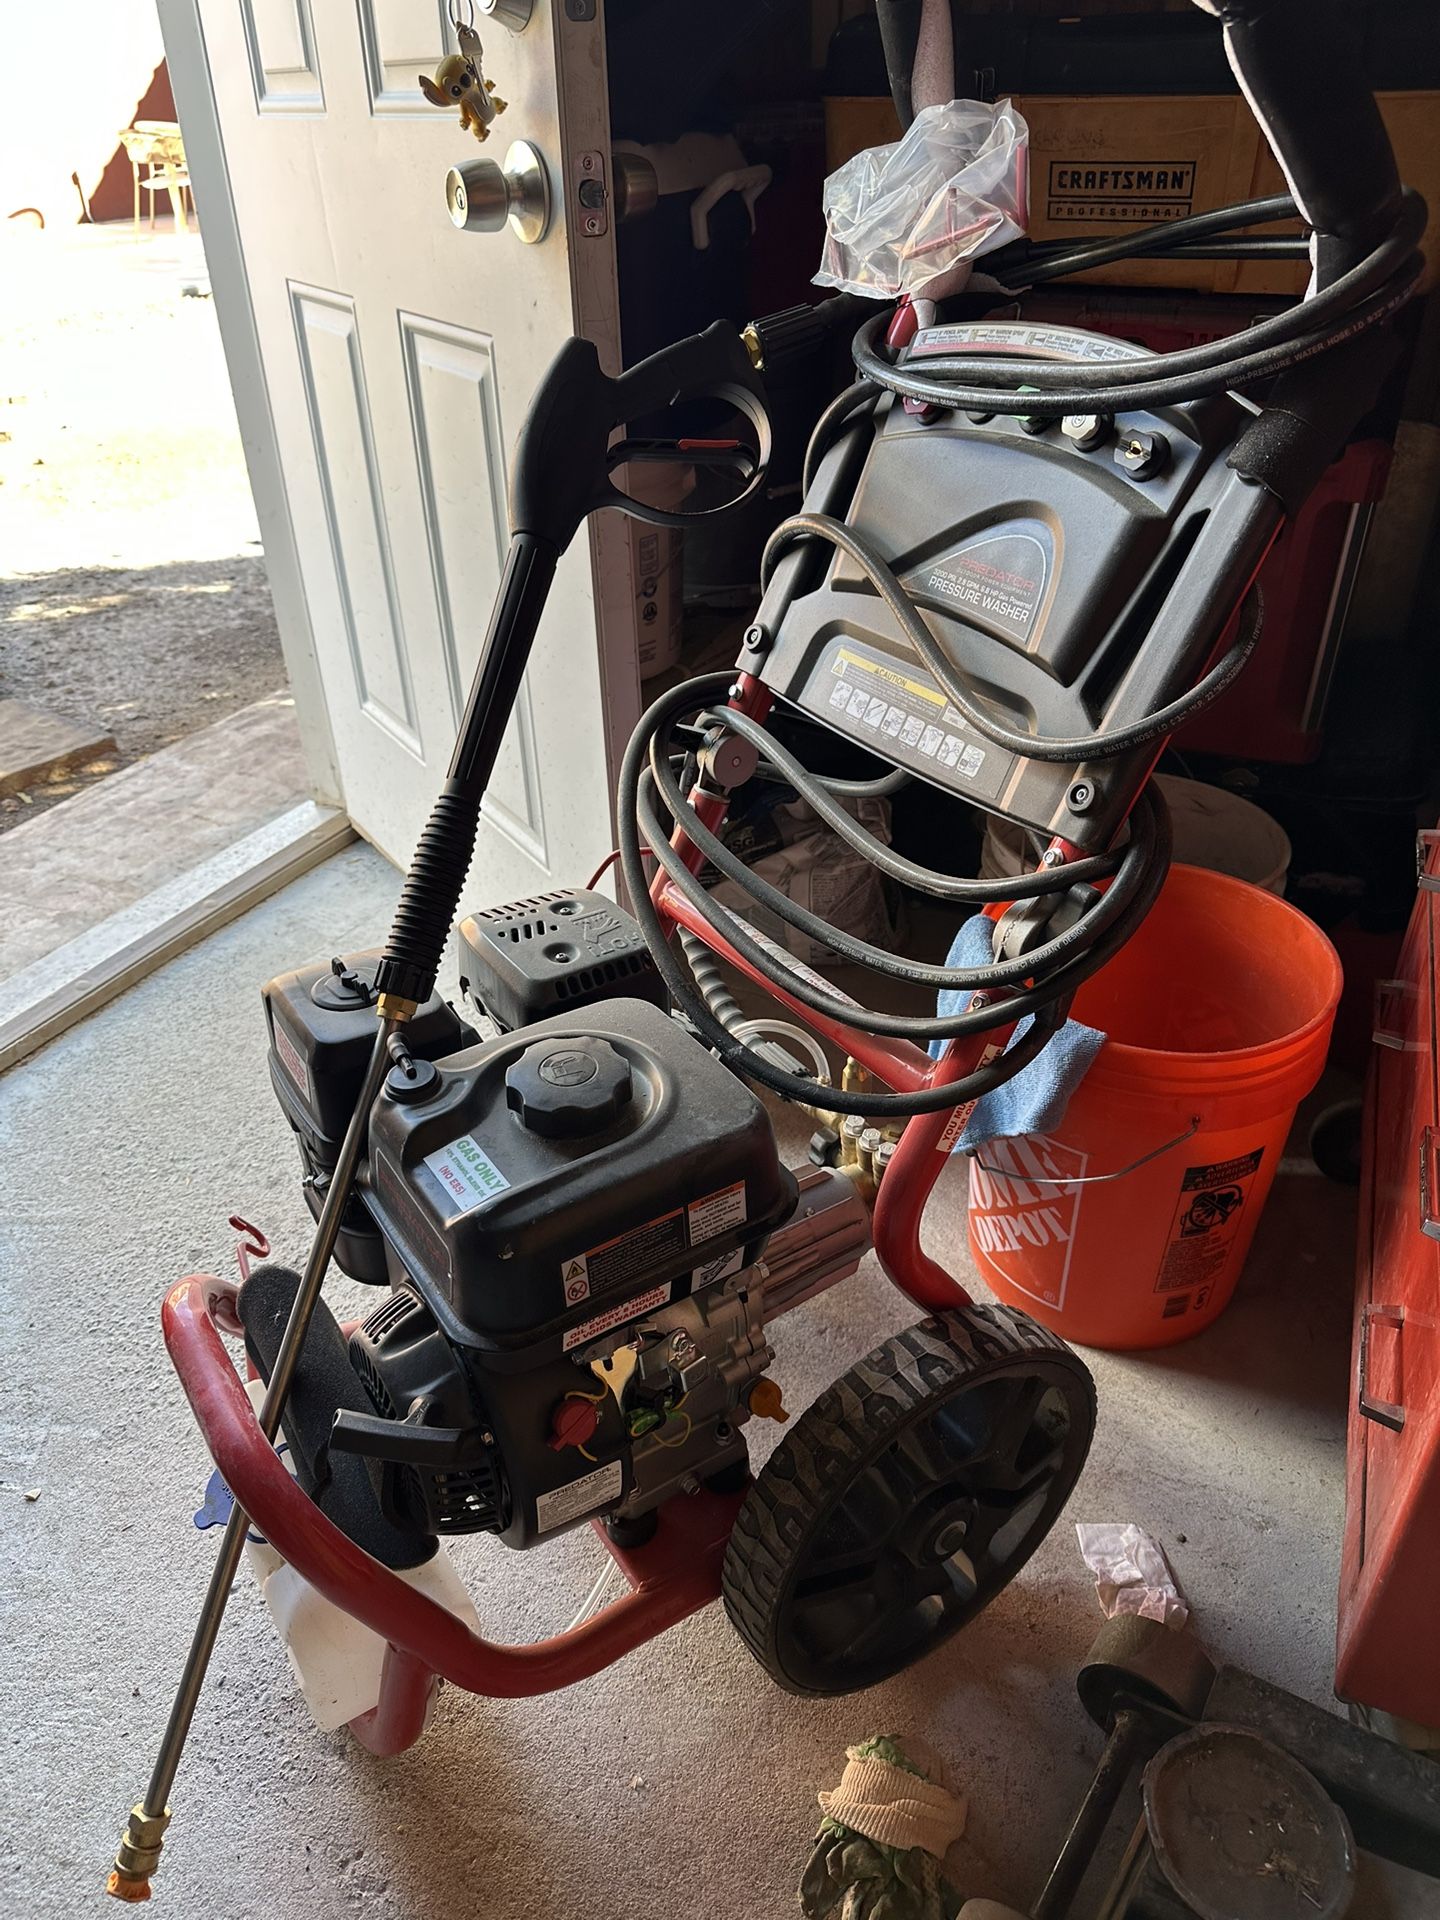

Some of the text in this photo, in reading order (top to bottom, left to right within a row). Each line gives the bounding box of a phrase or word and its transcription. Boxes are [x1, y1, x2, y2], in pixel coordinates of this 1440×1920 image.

[1058, 170, 1184, 190] CRAFTSMAN
[1055, 207, 1182, 217] PROFESSIONAL
[1294, 343, 1325, 362] WATER
[1327, 329, 1351, 347] HOSE
[928, 576, 1030, 623] PRESSURE WASHER
[1009, 595, 1033, 610] Powered
[1104, 741, 1130, 754] WATER
[1133, 730, 1155, 744] HOSE
[1029, 942, 1061, 964] GERMANY
[1062, 924, 1088, 947] DESIGN
[942, 1120, 957, 1141] YOU
[439, 1165, 466, 1196] (NO E85)
[456, 1139, 505, 1190] GAS ONLY
[974, 1206, 1071, 1252] DEPOT
[566, 1295, 668, 1348] OR VOIDS WARRANTY
[569, 1328, 587, 1339] OIL
[589, 1310, 621, 1329] EVERY
[631, 1290, 665, 1309] HOURS
[548, 1466, 612, 1500] PREDATOR
